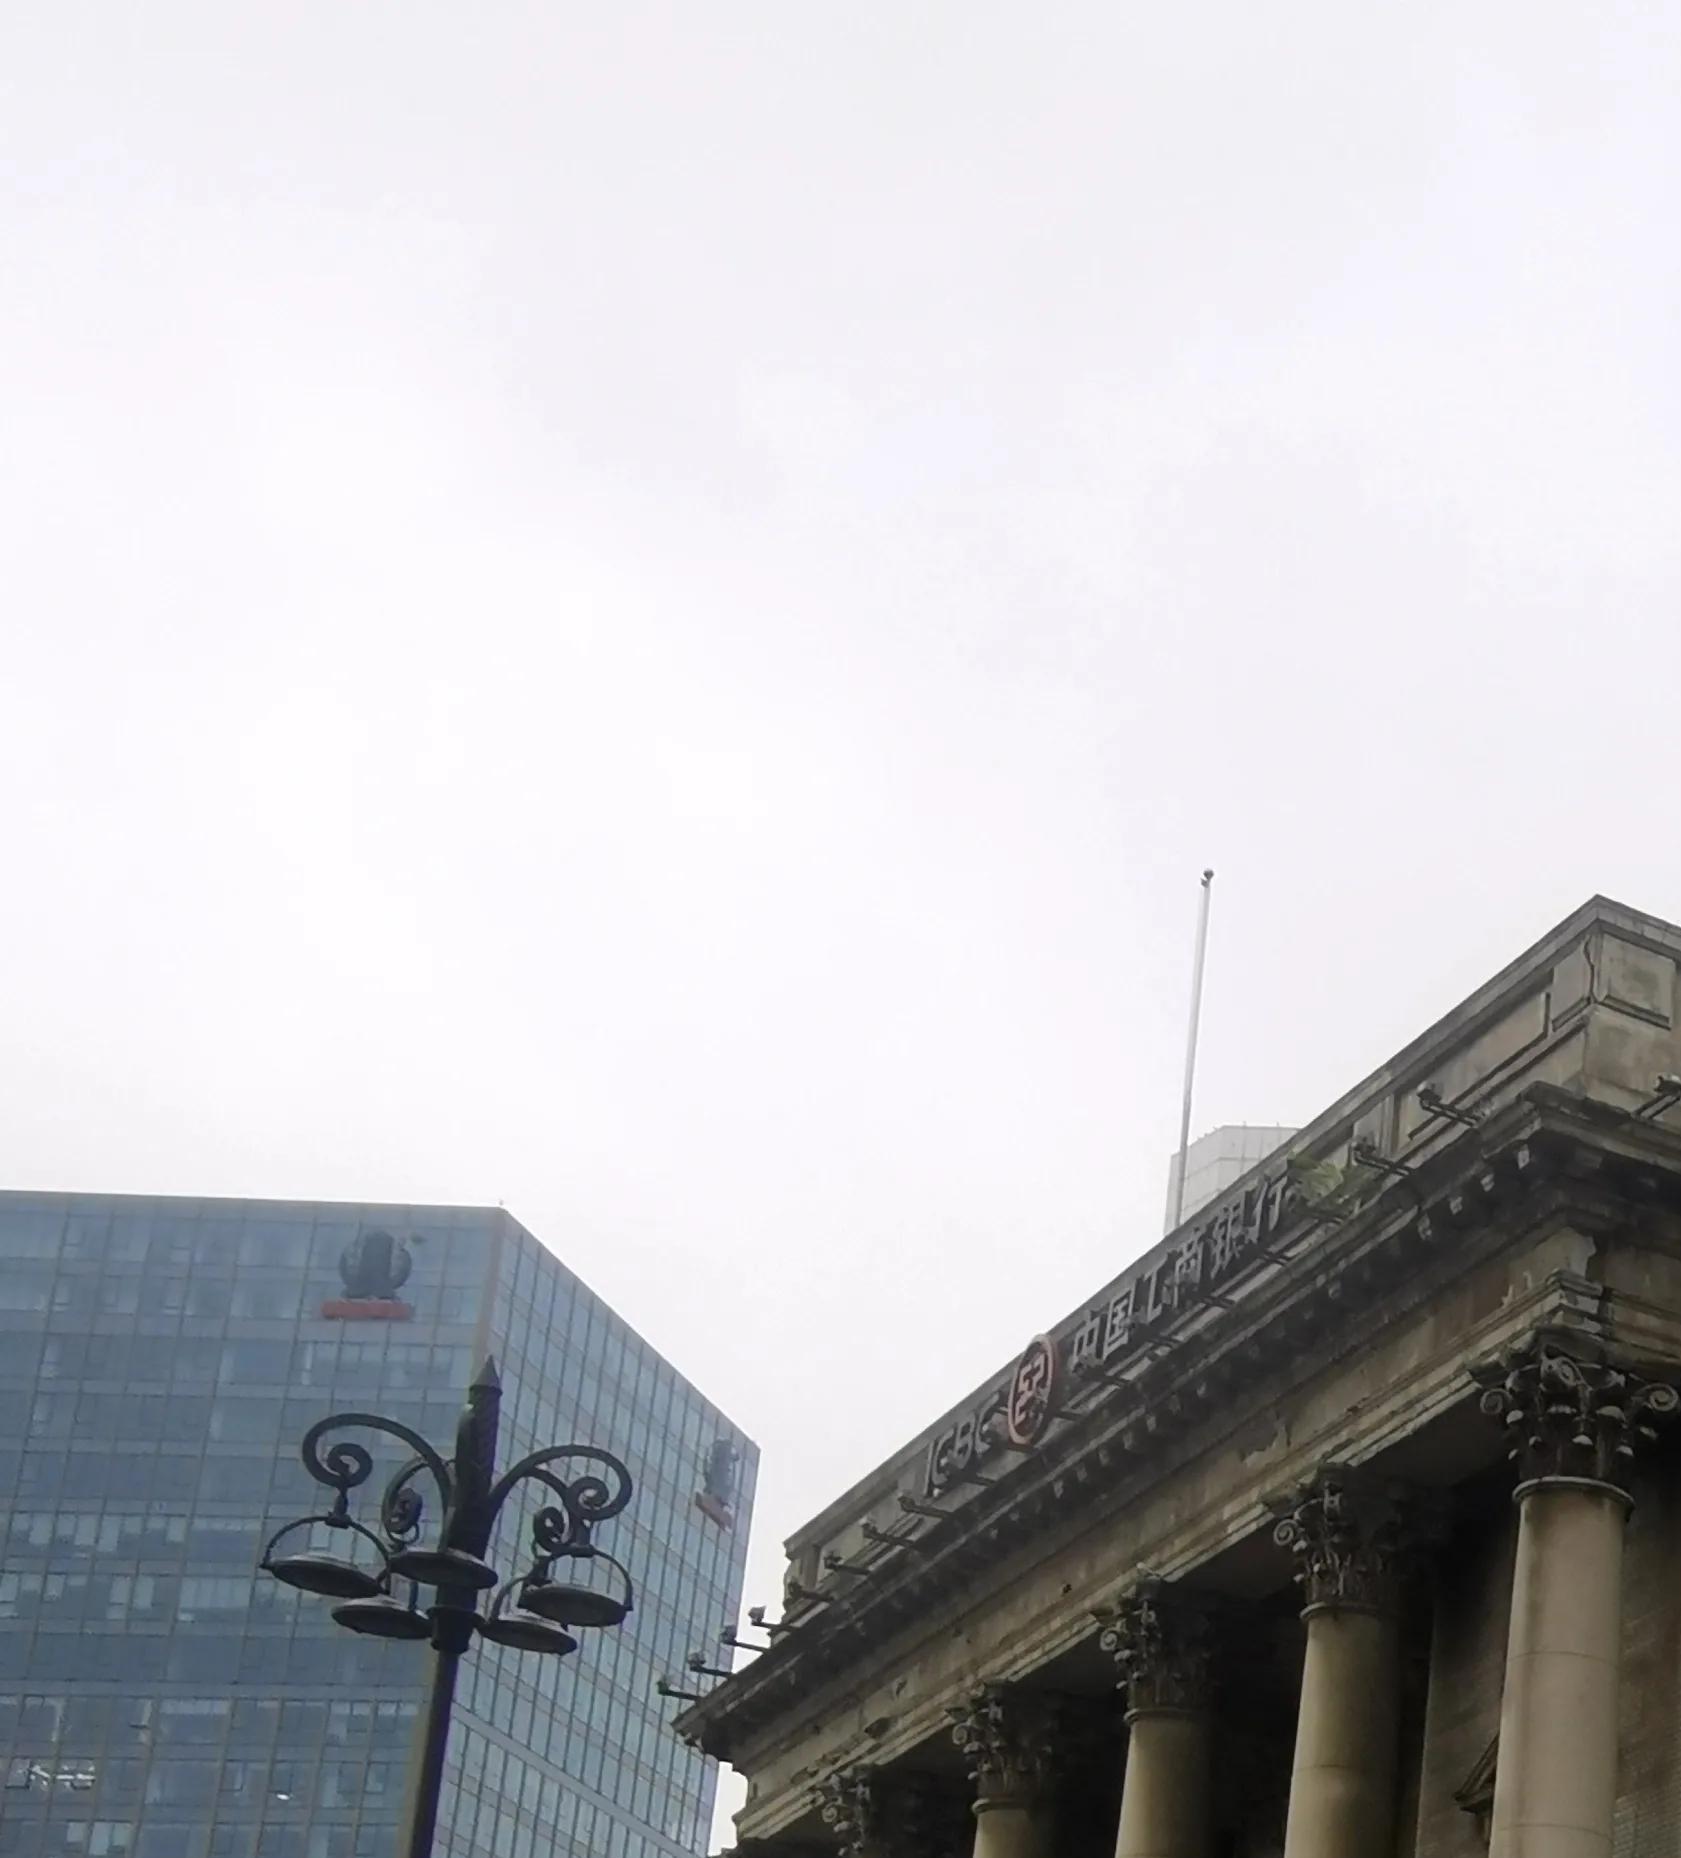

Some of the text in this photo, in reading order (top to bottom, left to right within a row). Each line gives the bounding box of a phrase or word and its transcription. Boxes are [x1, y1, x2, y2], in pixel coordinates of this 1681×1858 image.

[1069, 1174, 1288, 1372] 中国工商银行
[922, 1390, 1001, 1498] ICBC
